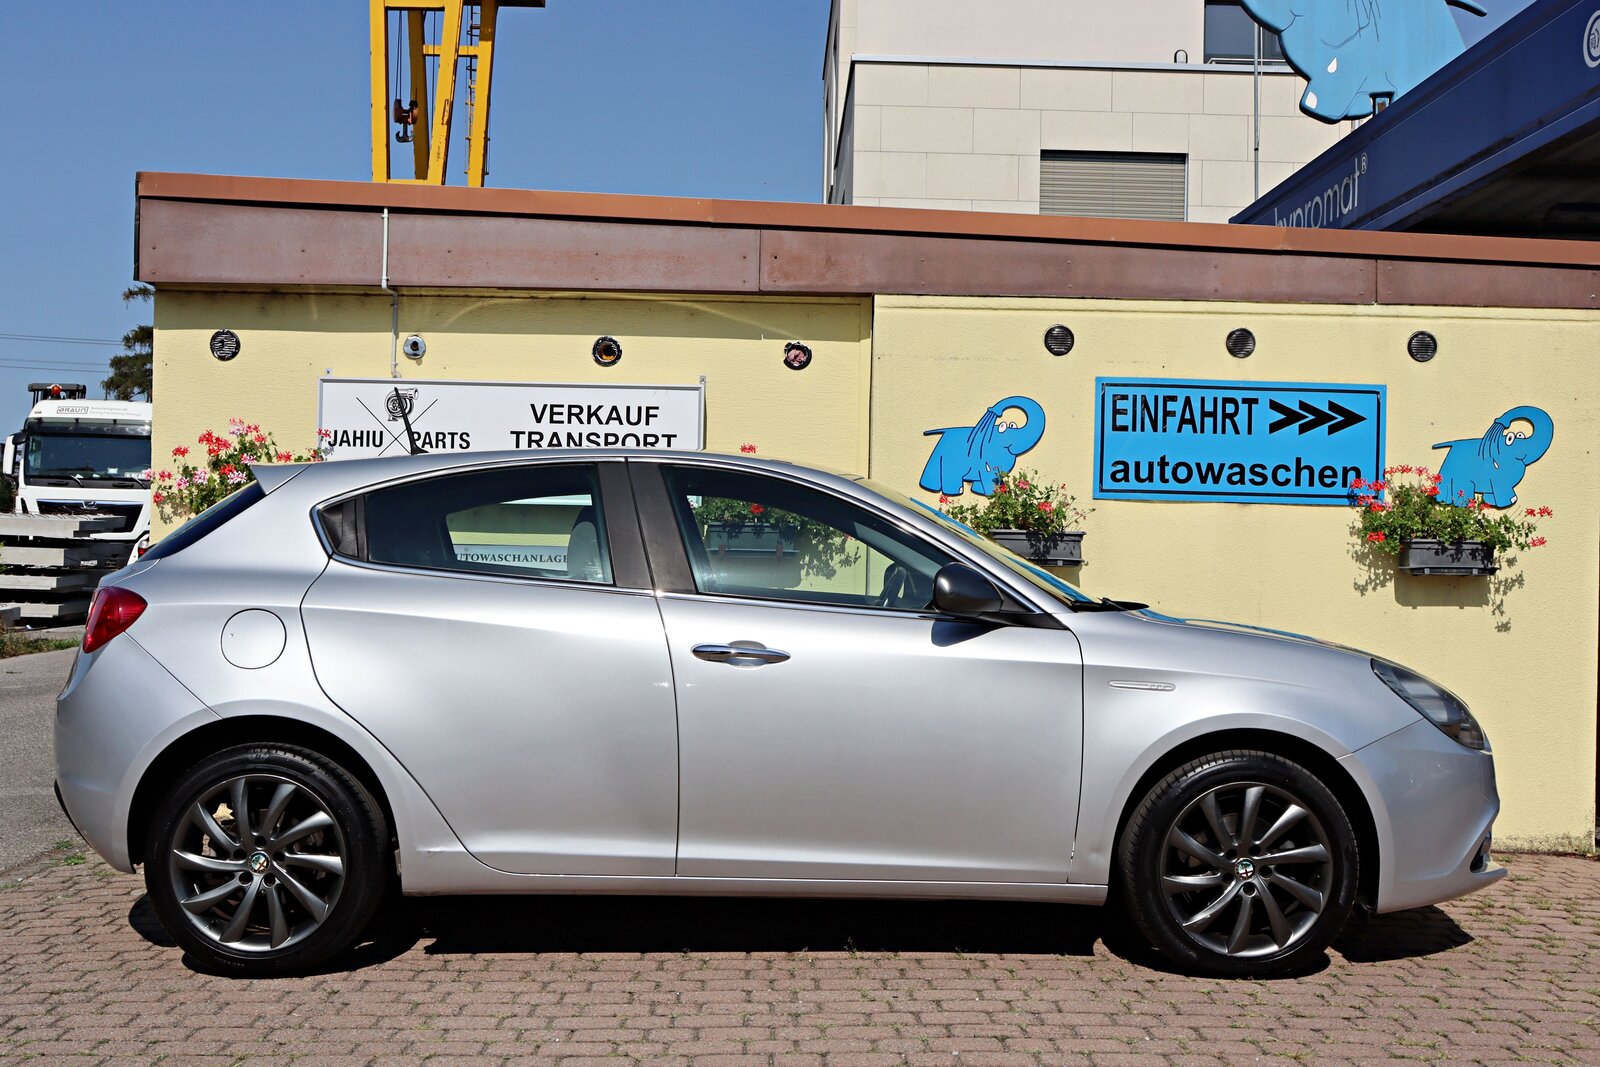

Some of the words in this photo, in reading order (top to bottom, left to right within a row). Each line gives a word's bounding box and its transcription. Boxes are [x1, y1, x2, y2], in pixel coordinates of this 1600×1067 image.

[530, 403, 660, 426] VERKAUF
[1111, 394, 1259, 436] EINFAHRT
[328, 430, 384, 447] JAHIU
[410, 431, 471, 449] PARTS
[510, 430, 678, 449] TRANSPORT
[1109, 454, 1362, 488] autowaschen
